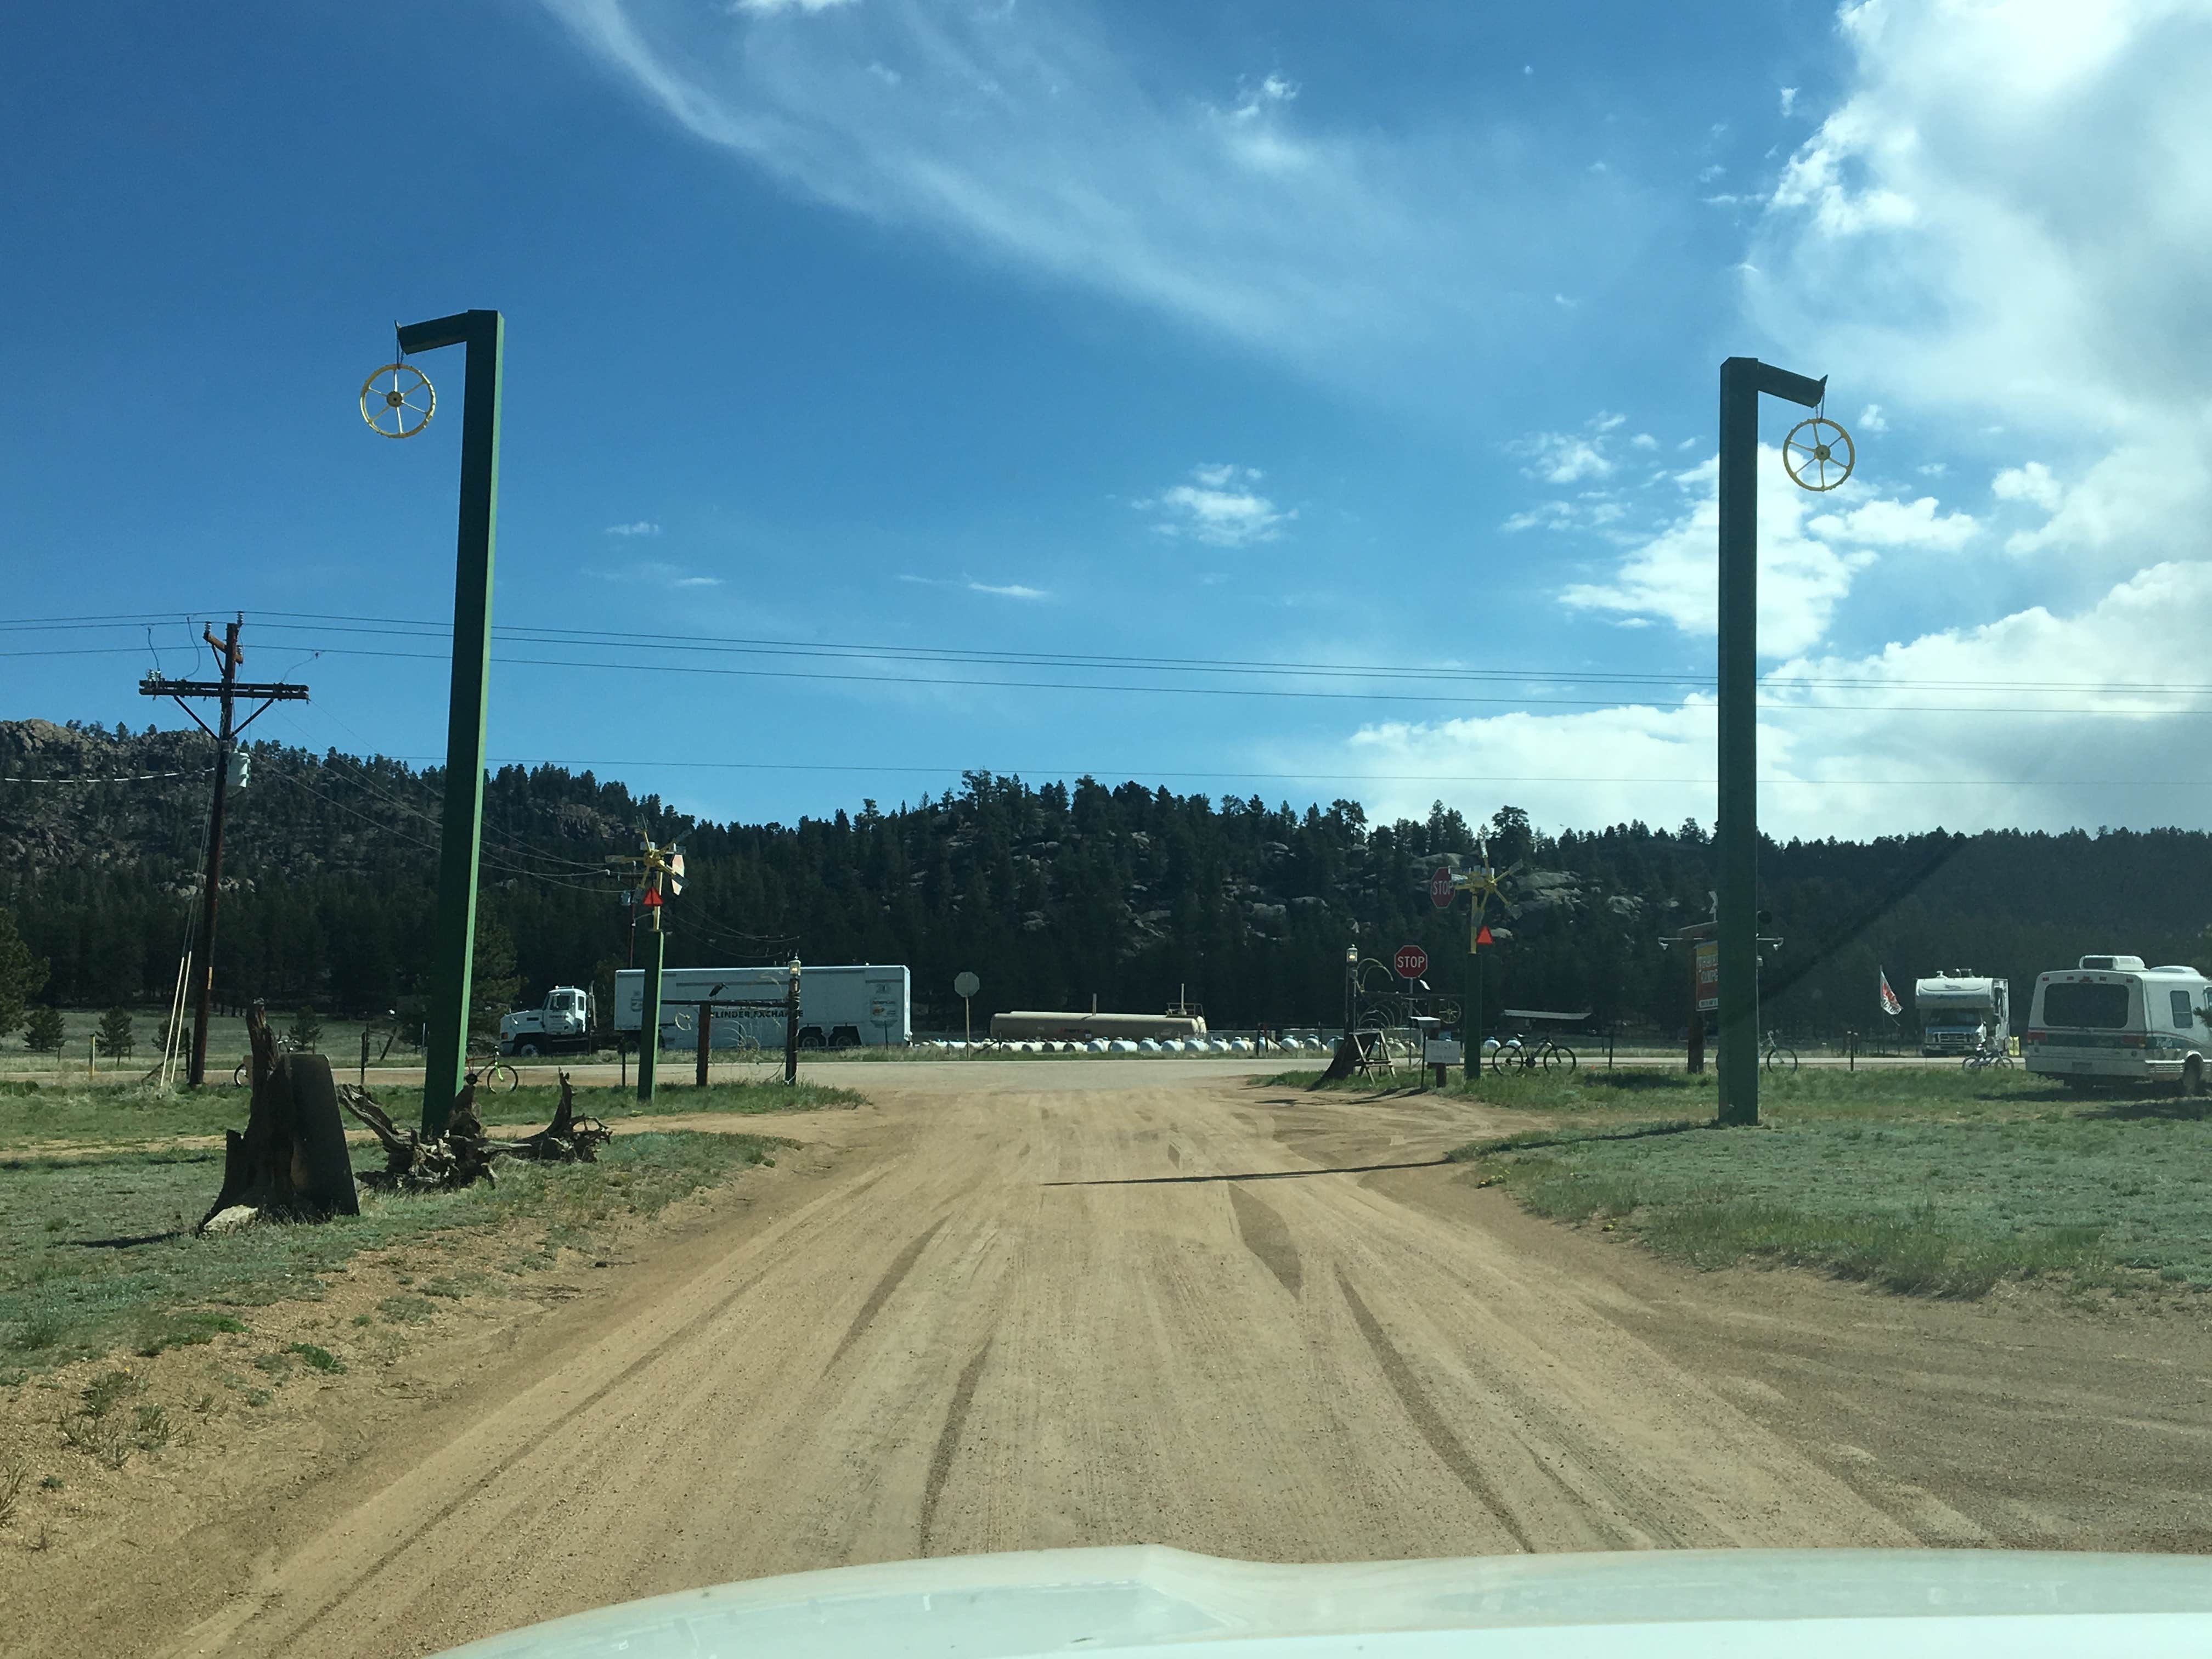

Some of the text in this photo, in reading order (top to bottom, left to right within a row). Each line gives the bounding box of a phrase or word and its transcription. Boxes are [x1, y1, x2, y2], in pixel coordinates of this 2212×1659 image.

[1432, 880, 1453, 895] STOP
[1397, 956, 1425, 968] STOP
[754, 1009, 804, 1018] EXCHAE
